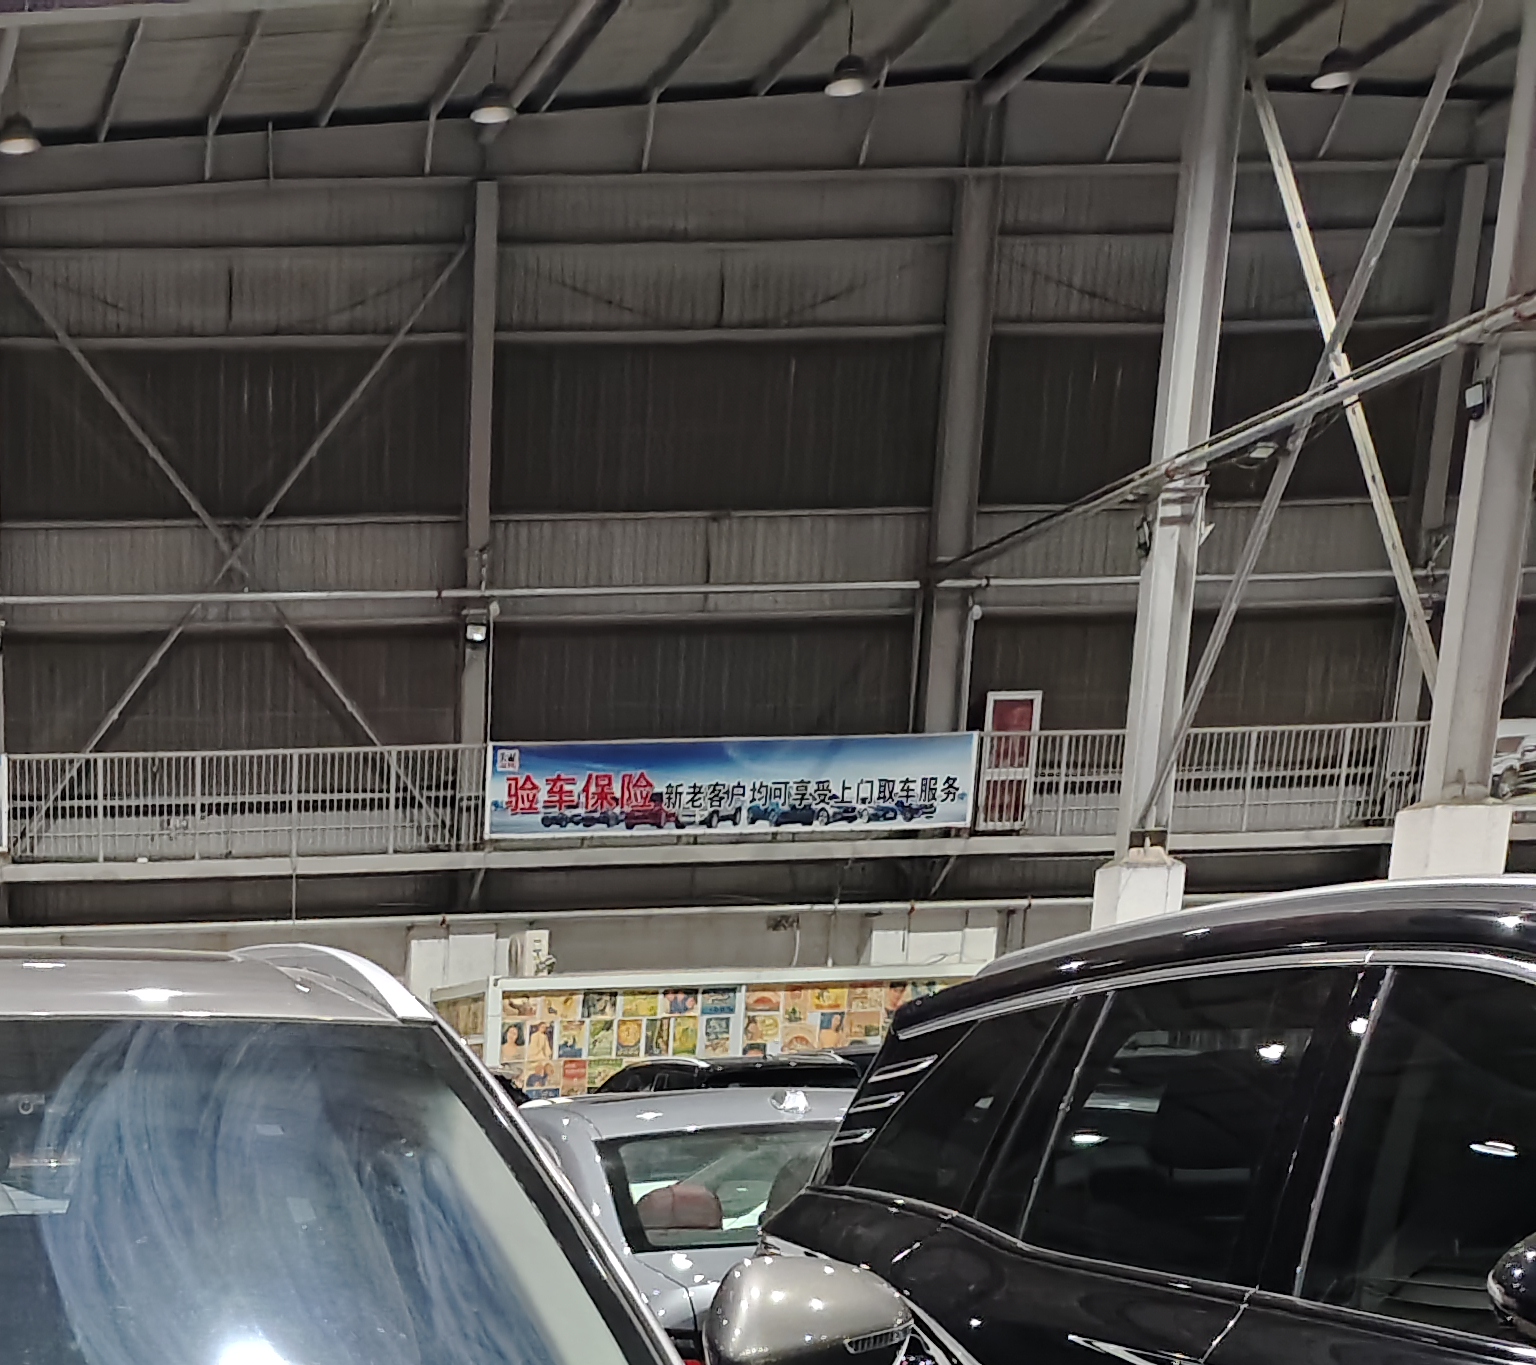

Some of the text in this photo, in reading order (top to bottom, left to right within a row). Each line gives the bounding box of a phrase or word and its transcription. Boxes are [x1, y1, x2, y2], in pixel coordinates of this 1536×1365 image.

[505, 772, 654, 815] 验车保险
[664, 776, 960, 810] 新老客户均可享受上门取车服务
